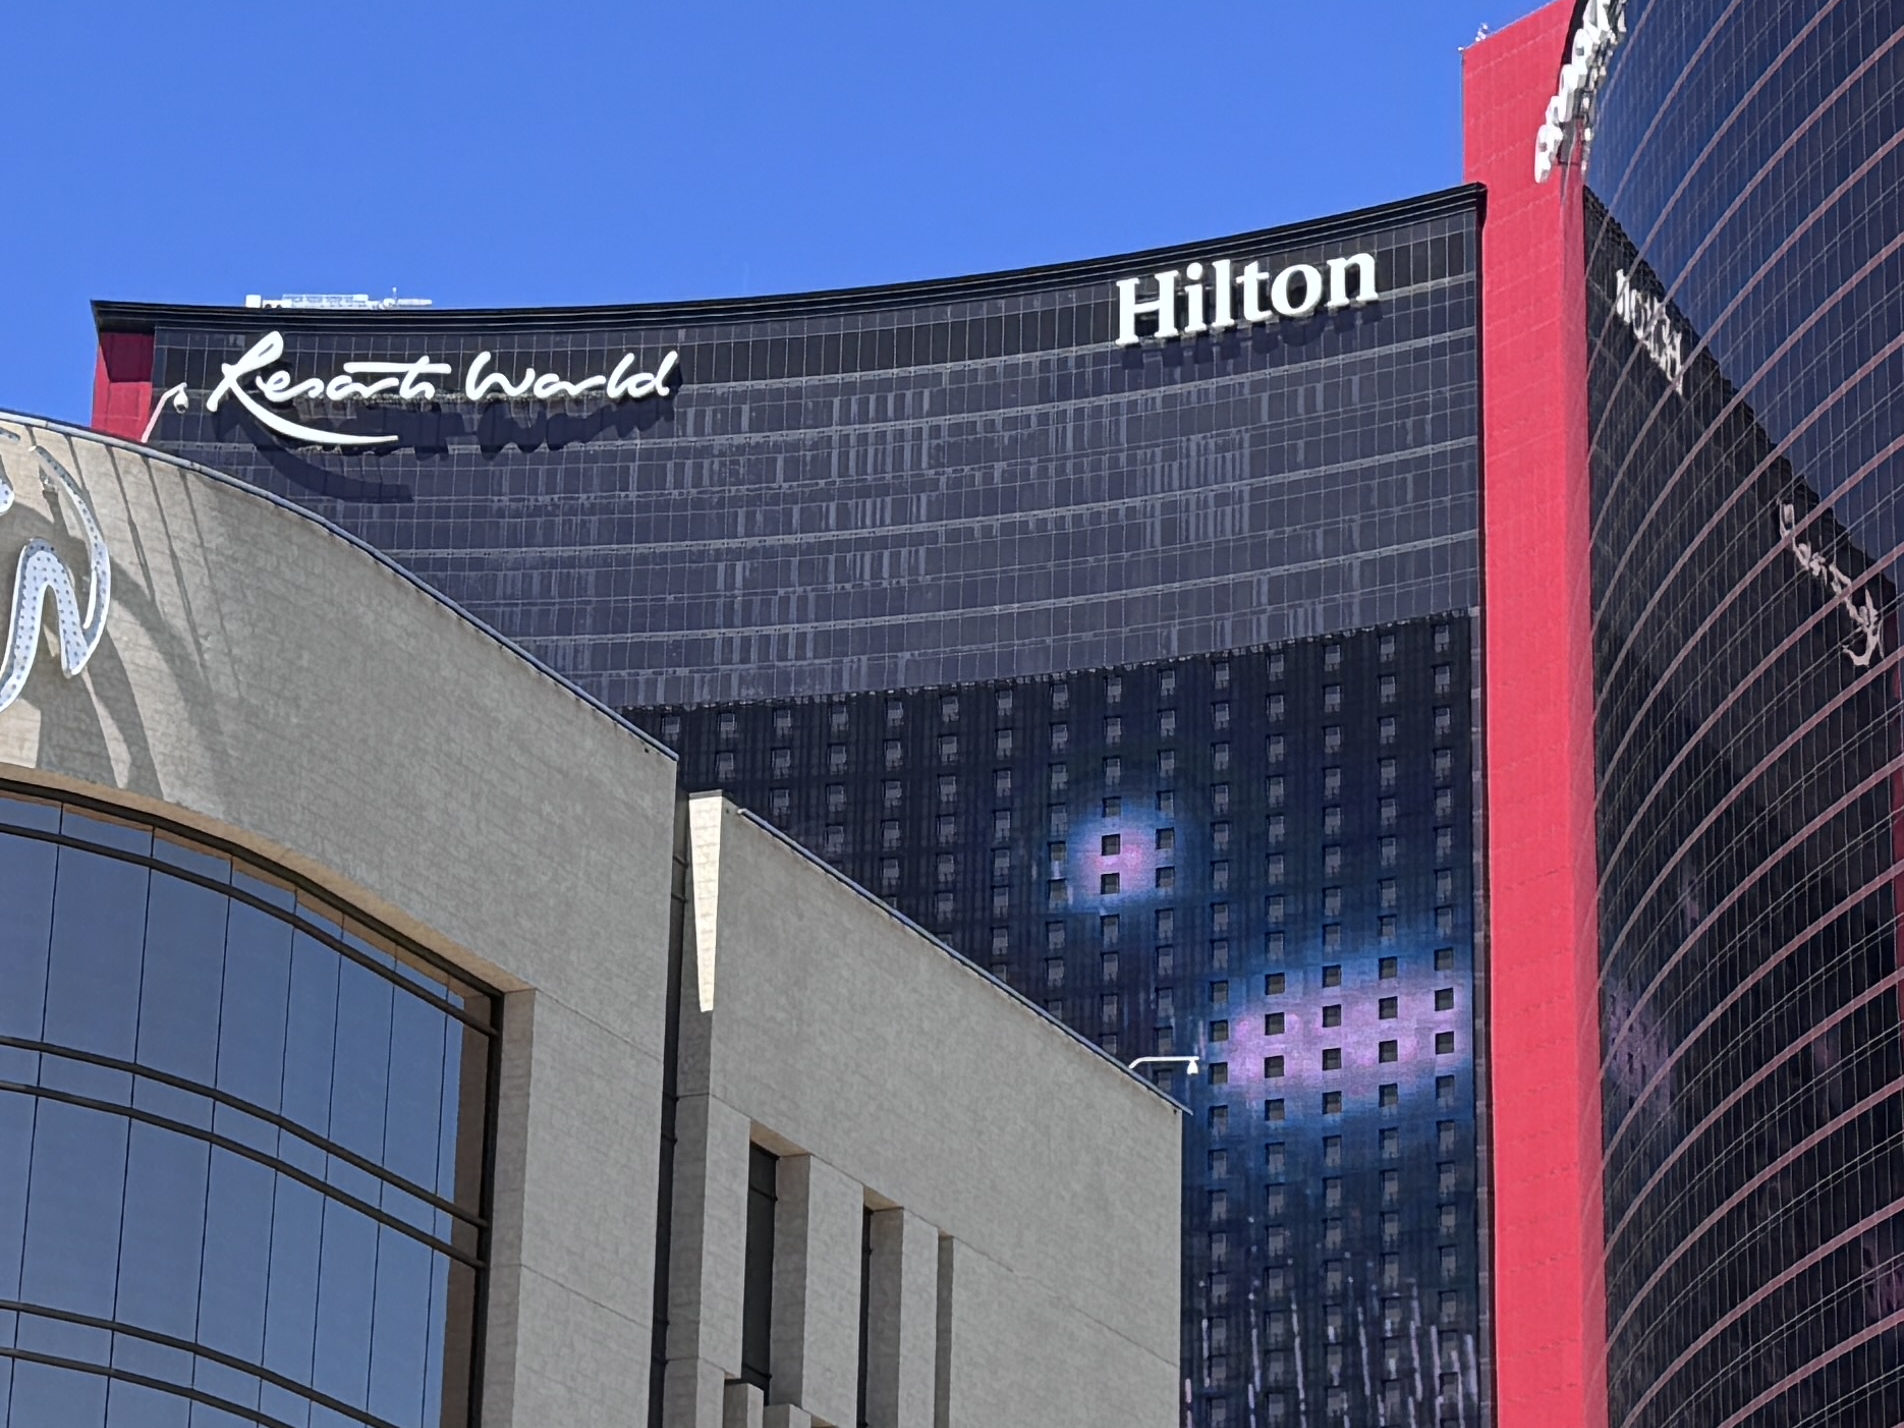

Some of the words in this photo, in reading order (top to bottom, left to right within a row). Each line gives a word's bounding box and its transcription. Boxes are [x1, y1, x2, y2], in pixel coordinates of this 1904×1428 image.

[1115, 253, 1379, 345] Hilton
[206, 331, 451, 445] Resorts
[466, 351, 678, 401] World
